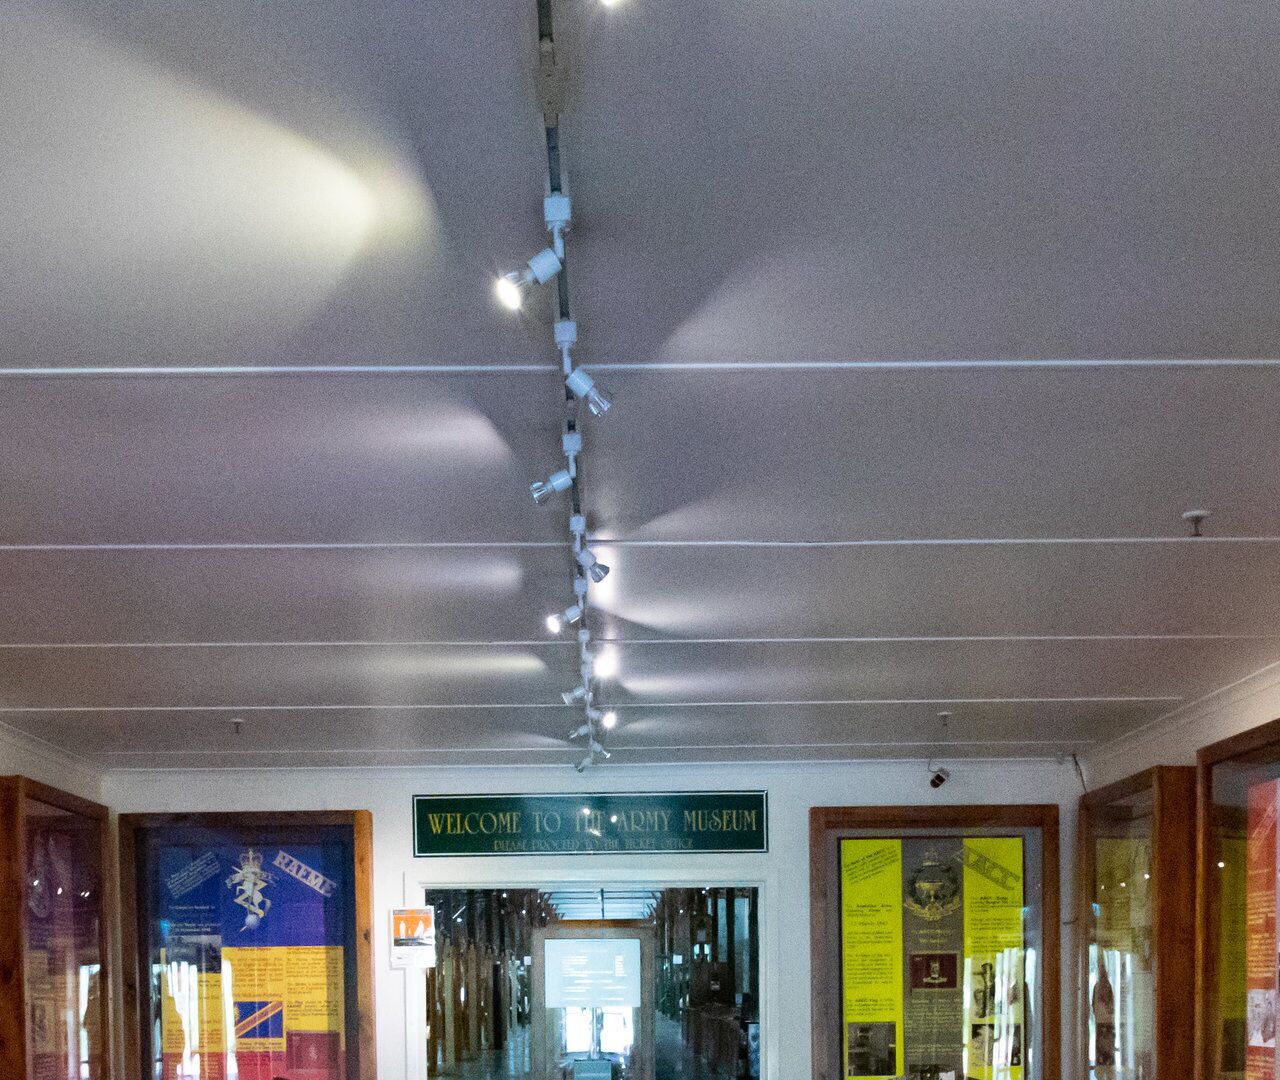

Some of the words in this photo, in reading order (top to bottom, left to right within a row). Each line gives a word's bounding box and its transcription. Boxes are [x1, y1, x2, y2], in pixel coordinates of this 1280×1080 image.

[428, 812, 521, 834] WELCOME
[533, 811, 561, 833] TO
[618, 810, 670, 832] ARMY
[683, 809, 757, 831] MUSEUM
[272, 849, 337, 897] RAEME
